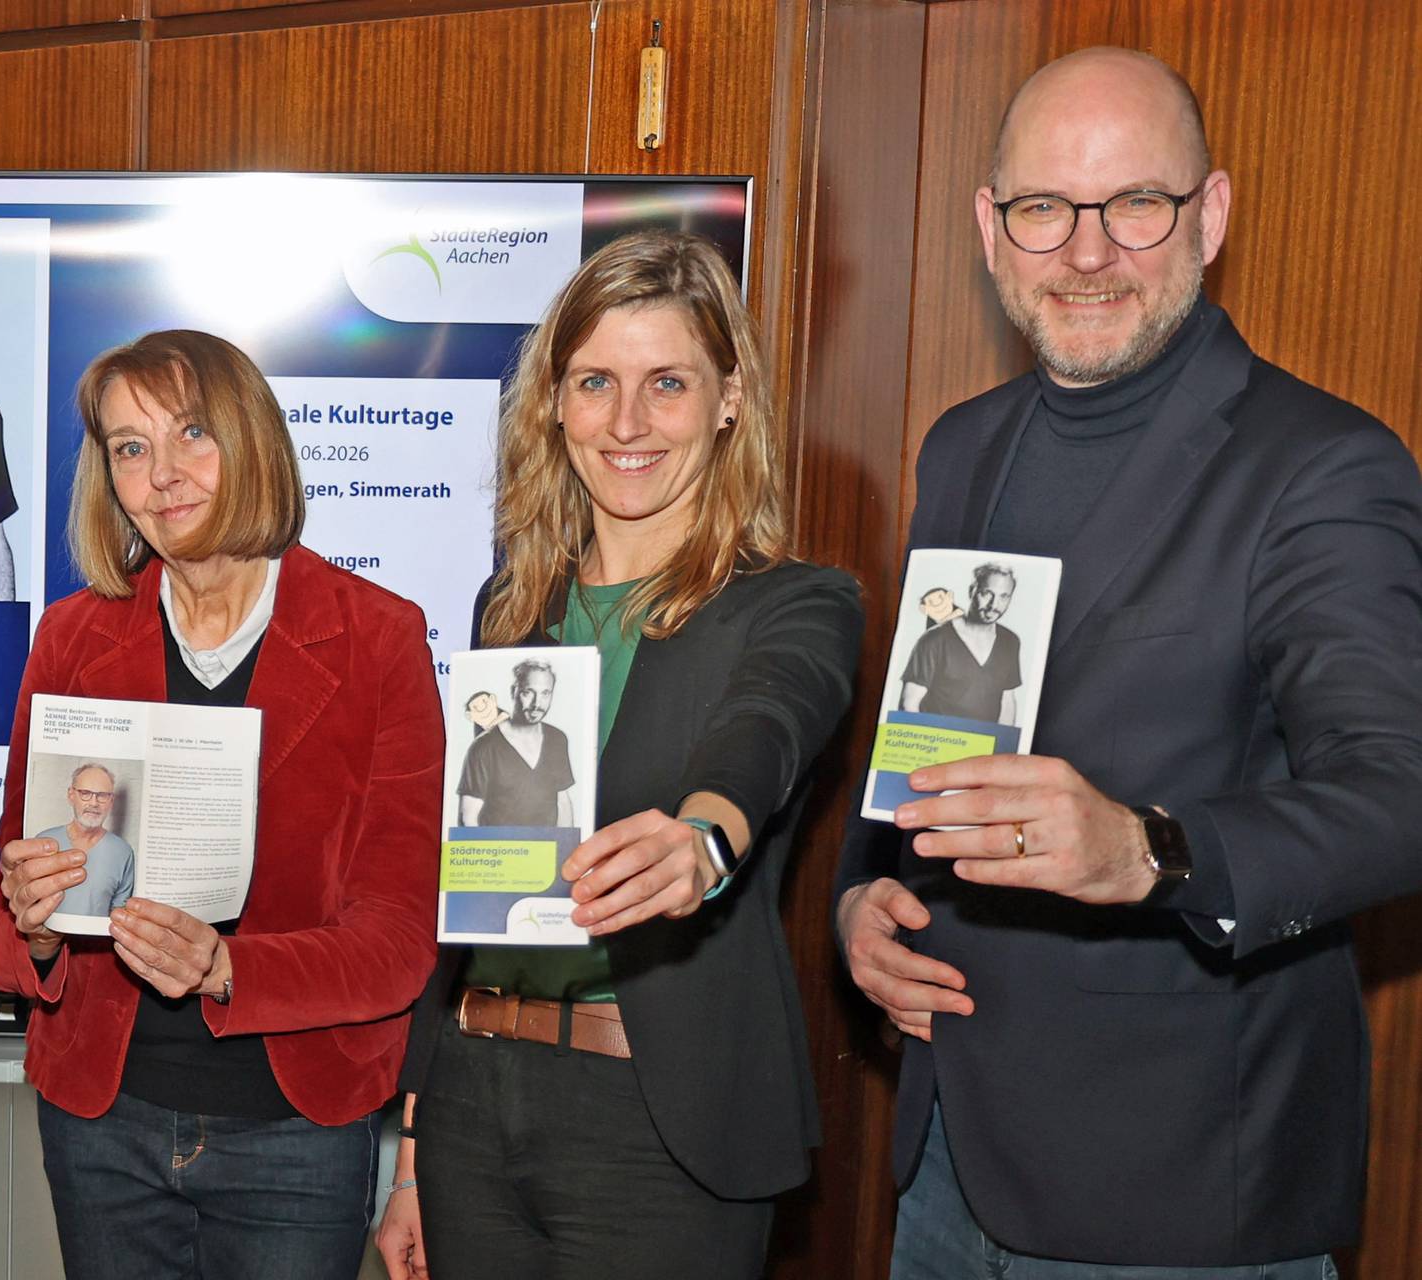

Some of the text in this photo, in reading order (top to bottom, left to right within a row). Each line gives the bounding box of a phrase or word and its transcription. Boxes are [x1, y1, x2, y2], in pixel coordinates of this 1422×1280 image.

[446, 247, 510, 264] Aachen
[328, 404, 454, 430] Kulturtage
[349, 482, 451, 498] Simmerath
[58, 721, 100, 730] GESCHICHTE
[886, 728, 968, 746] Städteregionale
[884, 739, 939, 753] Kulturtage
[449, 847, 529, 857] Städteregionale
[449, 858, 503, 867] Kulturtage
